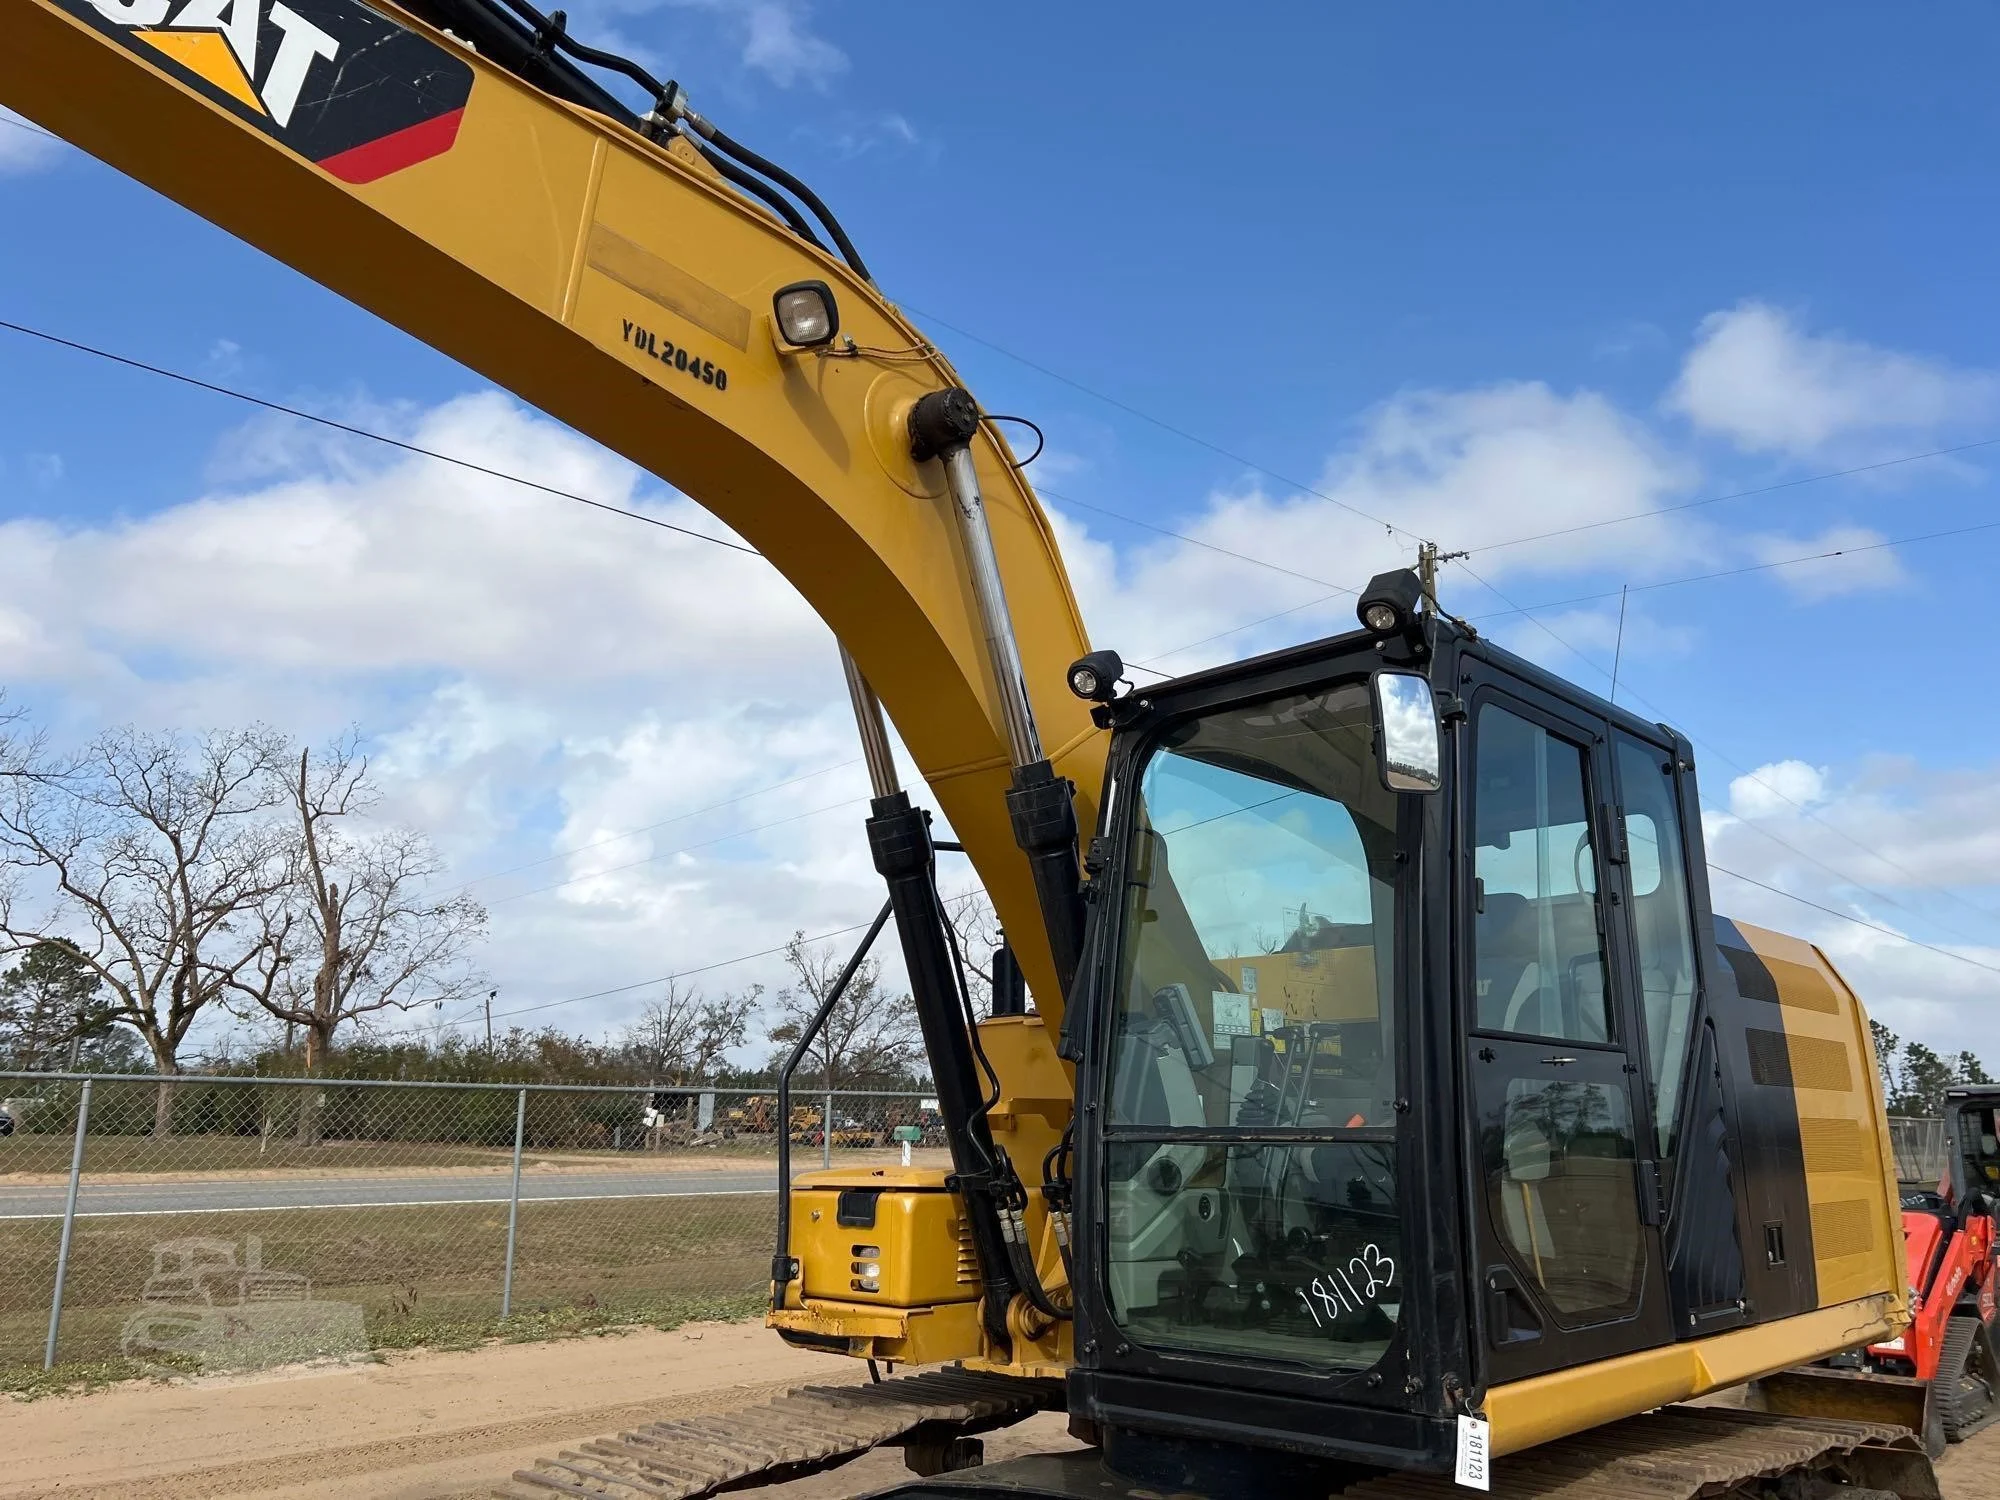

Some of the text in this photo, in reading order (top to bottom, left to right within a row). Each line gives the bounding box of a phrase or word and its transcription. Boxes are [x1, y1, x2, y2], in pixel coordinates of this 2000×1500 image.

[622, 318, 727, 391] YDL20450
[1299, 1243, 1395, 1328] 181123
[1468, 1434, 1483, 1480] 181123
